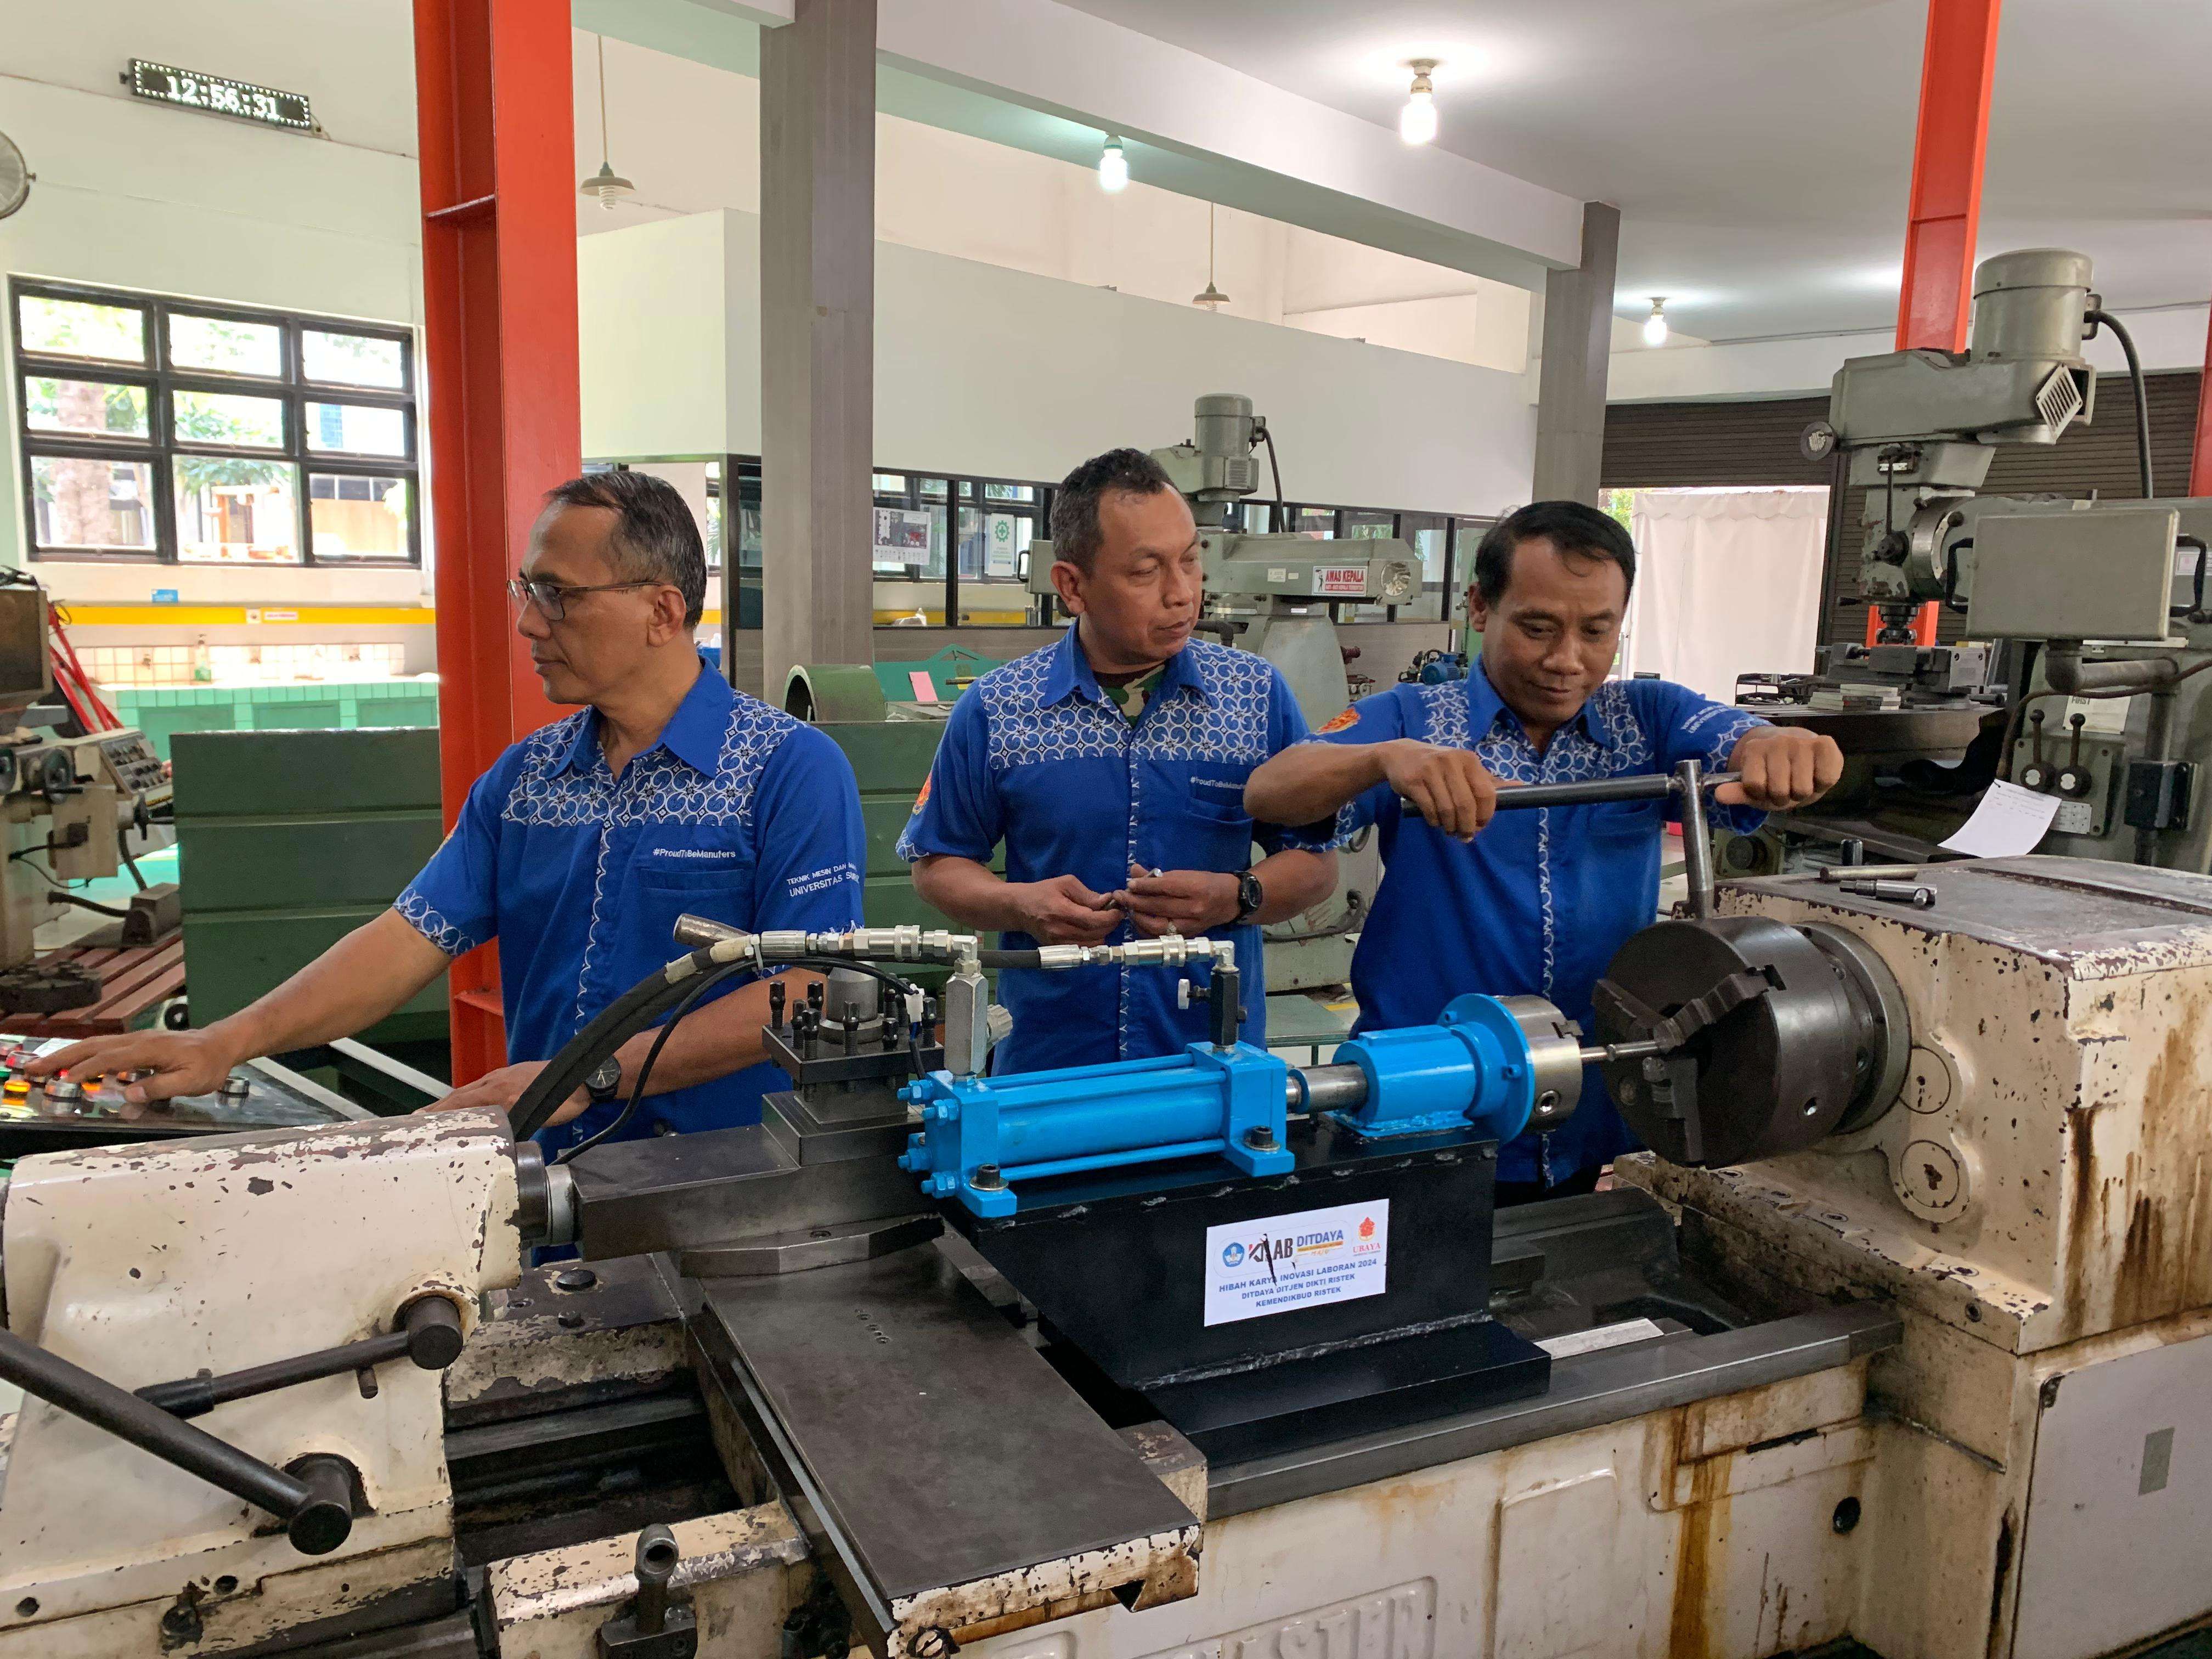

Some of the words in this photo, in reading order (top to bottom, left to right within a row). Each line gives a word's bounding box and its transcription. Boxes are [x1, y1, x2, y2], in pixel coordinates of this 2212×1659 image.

[1325, 570, 1341, 582] AWAS
[1342, 570, 1364, 583] KEPALA
[786, 873, 810, 885] TEKNIK
[811, 867, 831, 878] MESIN
[833, 863, 847, 872] DAN
[789, 874, 843, 897] UNIVERSITAS
[1297, 1229, 1344, 1247] DITDAYA
[1353, 1242, 1381, 1253] UBAYA
[1219, 1281, 1246, 1293] HIBAH
[1280, 1269, 1314, 1282] INOVASI
[1316, 1262, 1355, 1276] LABORAN
[1358, 1259, 1376, 1268] 2024
[1242, 1288, 1274, 1300] DITDAYA
[1276, 1282, 1304, 1294] DITJEN
[1306, 1278, 1326, 1288] DIKTI
[1328, 1273, 1355, 1284] RISTEK
[1255, 1291, 1312, 1307] KEMENDIKBUD
[1314, 1286, 1341, 1297] RISTEK
